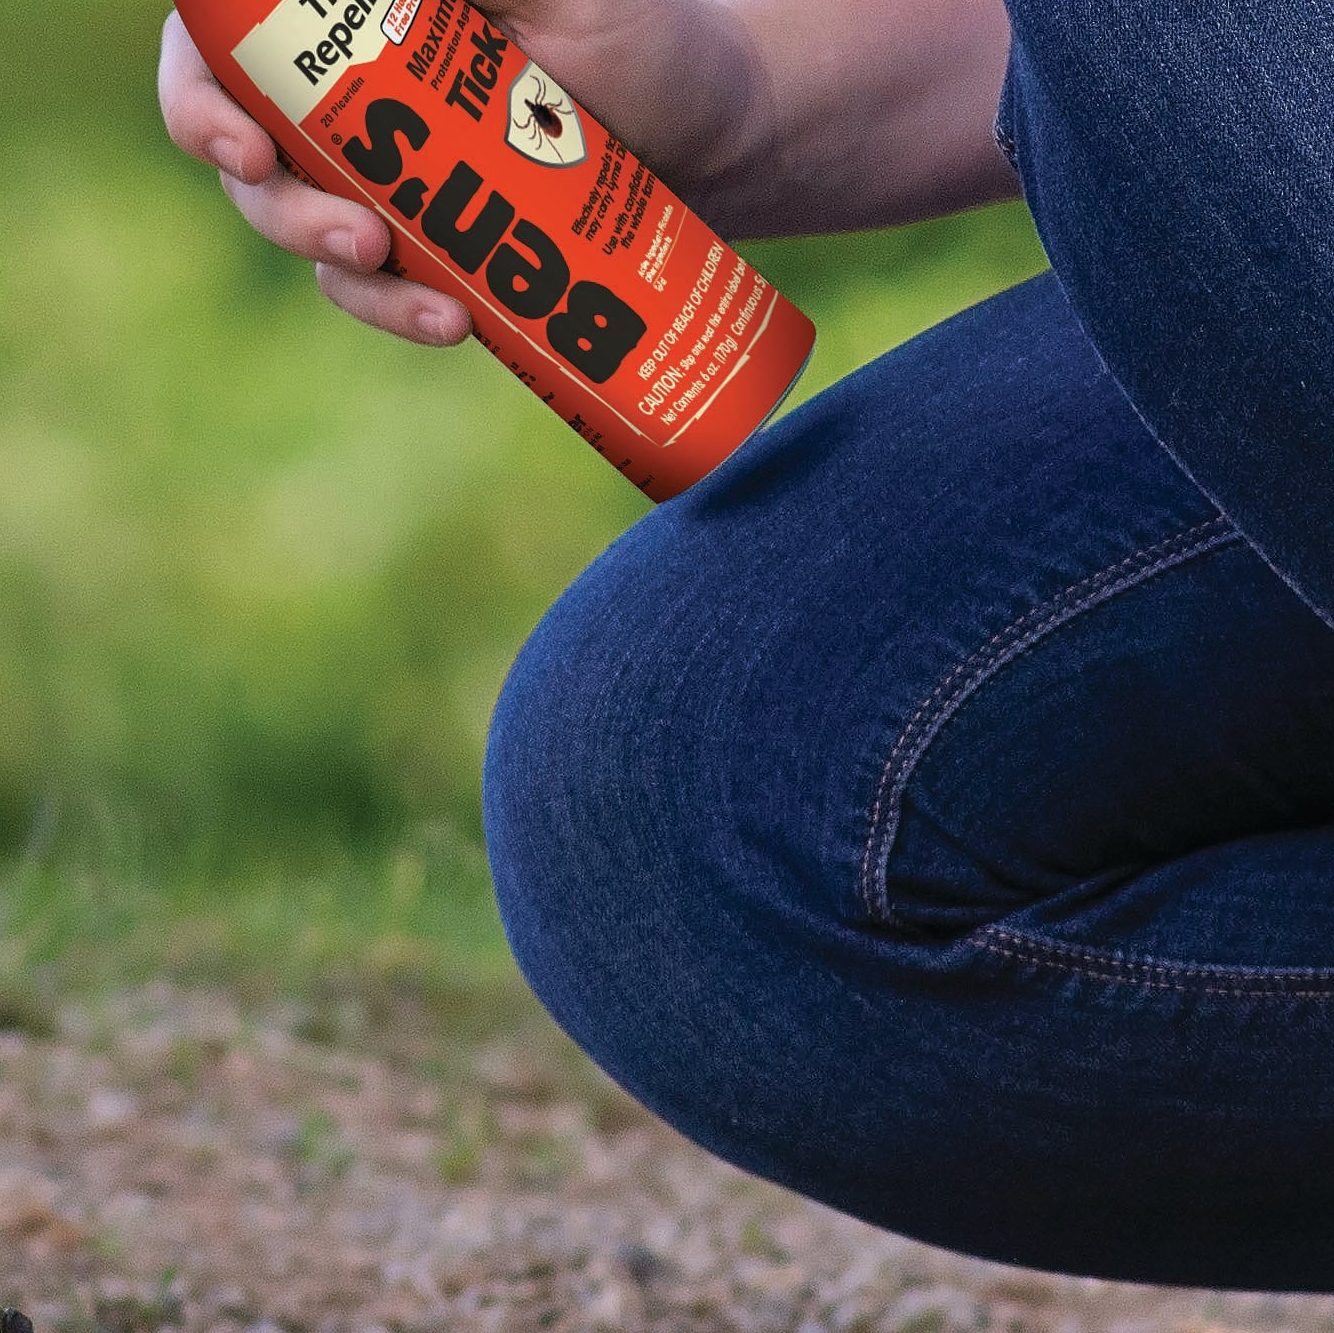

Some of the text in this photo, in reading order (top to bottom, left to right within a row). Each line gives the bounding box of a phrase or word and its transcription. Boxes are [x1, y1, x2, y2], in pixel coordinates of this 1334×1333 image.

[387, 12, 399, 27] 12
[430, 30, 462, 91] Protection
[445, 22, 514, 121] Tick
[596, 152, 613, 189] repels
[605, 160, 622, 191] Lyme
[596, 190, 615, 219] carry
[602, 163, 647, 256] Use with confiden
[620, 173, 656, 249] the whole fam
[585, 217, 602, 242] may
[637, 241, 724, 381] KEEP OUT OF REACH OF CHILDREN
[730, 285, 763, 336] Continuous
[638, 365, 686, 415] CAUTION:
[679, 354, 697, 371] Stop
[691, 339, 706, 356] and
[708, 313, 722, 327] this
[724, 271, 741, 295] label
[712, 334, 738, 364] (170g)
[699, 370, 711, 382] 6
[706, 362, 721, 376] oz.
[660, 408, 678, 426] Net
